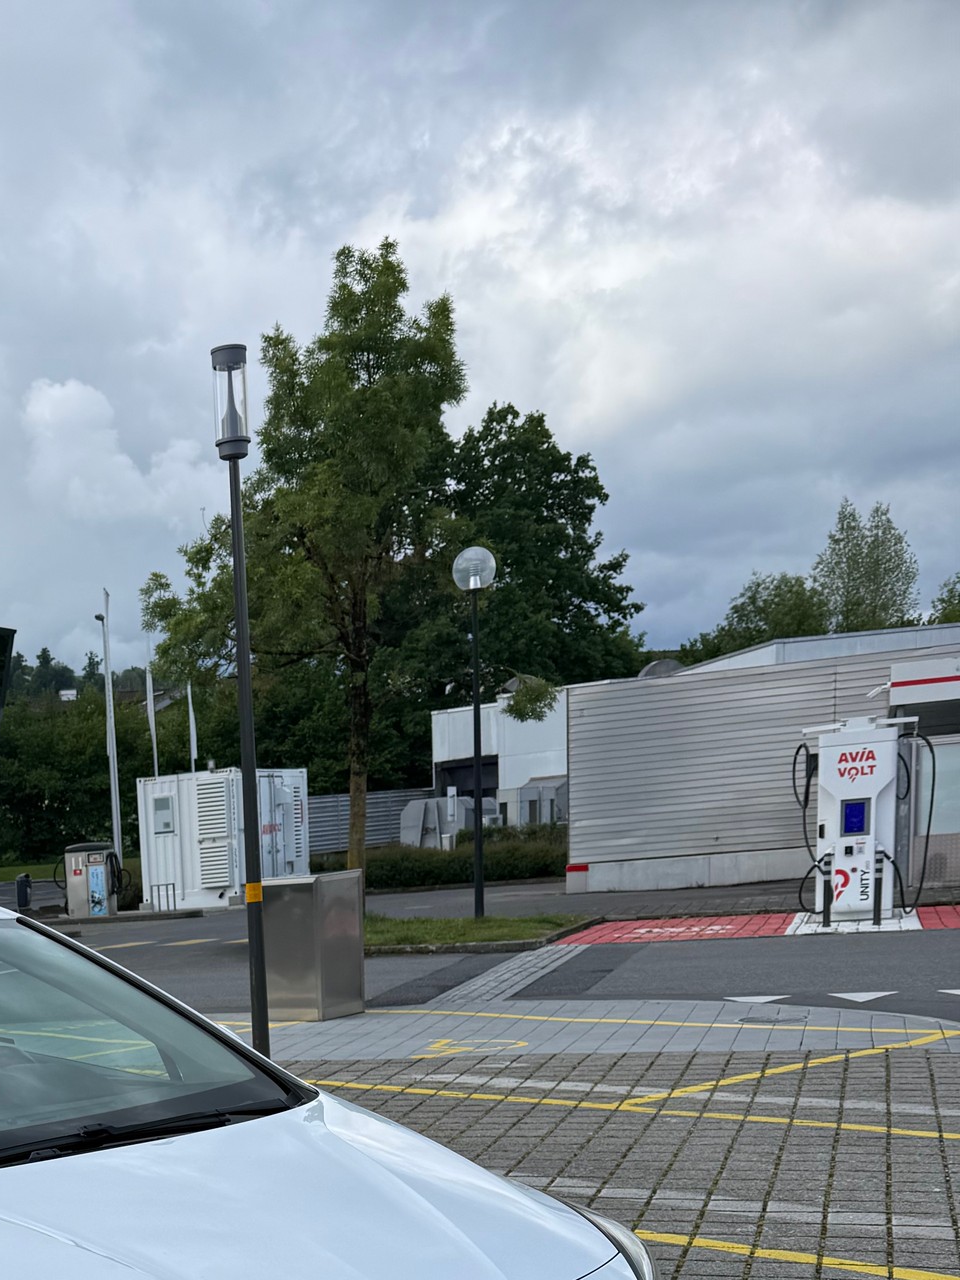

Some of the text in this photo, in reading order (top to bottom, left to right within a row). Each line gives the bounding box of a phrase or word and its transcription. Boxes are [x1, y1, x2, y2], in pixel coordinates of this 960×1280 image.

[838, 747, 876, 764] AVIA
[838, 765, 877, 783] VOLT
[859, 869, 871, 902] UNITY
